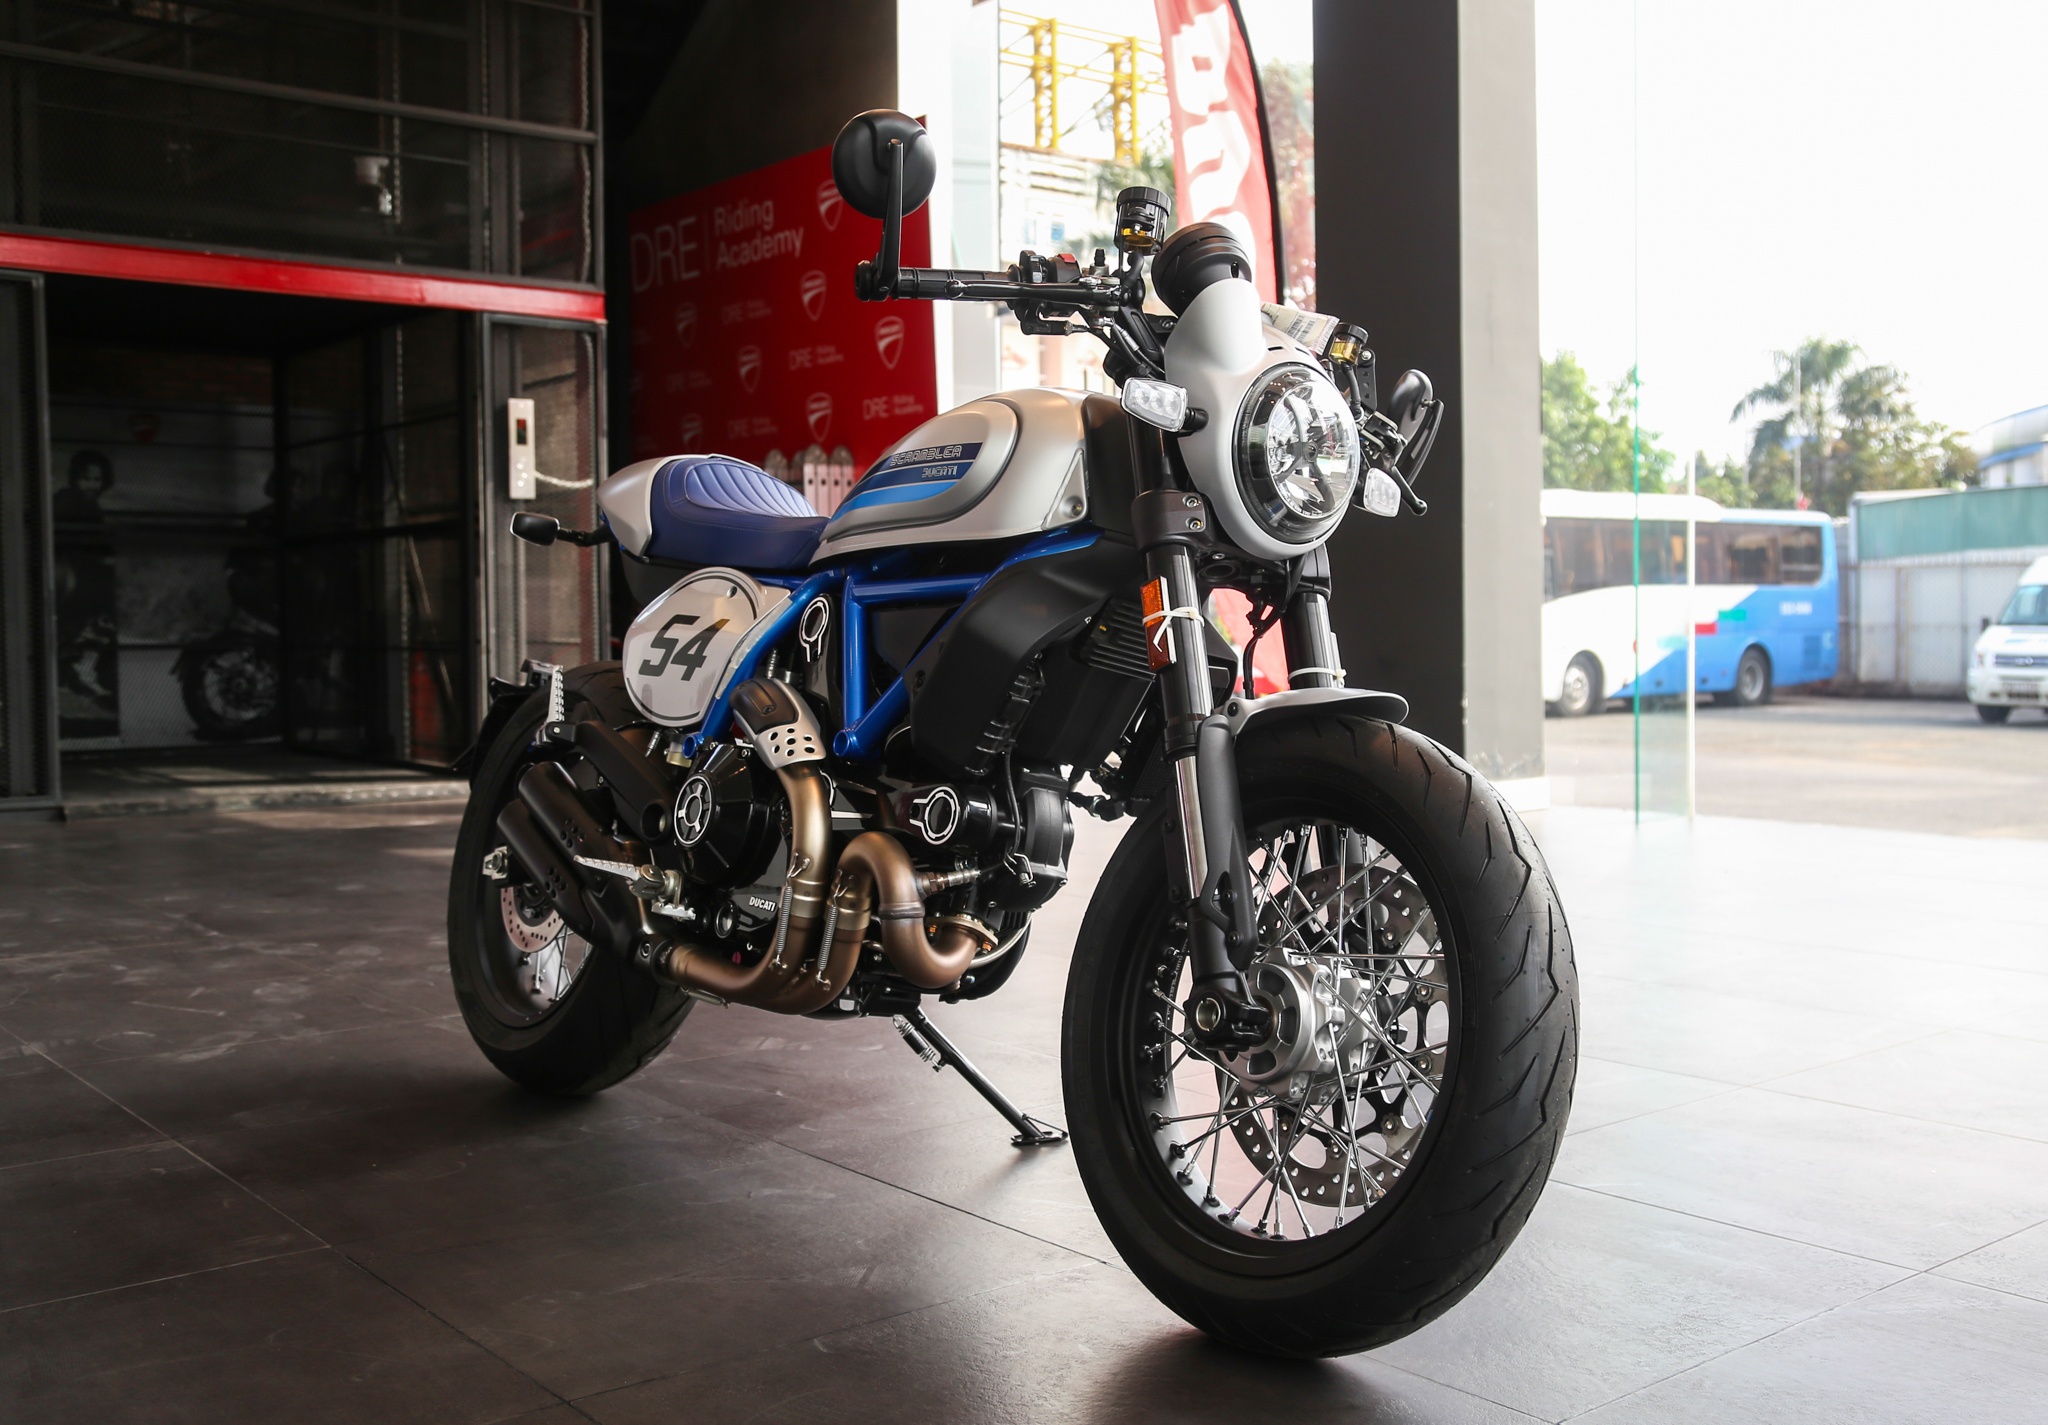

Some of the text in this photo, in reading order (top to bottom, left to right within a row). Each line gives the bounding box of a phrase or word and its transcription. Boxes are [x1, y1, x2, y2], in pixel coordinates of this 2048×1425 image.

[713, 198, 775, 237] Riding
[629, 216, 701, 294] DRE
[715, 227, 804, 270] Academy
[862, 396, 890, 421] DRE
[890, 445, 962, 467] SCRAMBLER
[921, 464, 958, 478] DUCATI
[638, 614, 731, 682] 54
[748, 896, 777, 912] DUCATI
